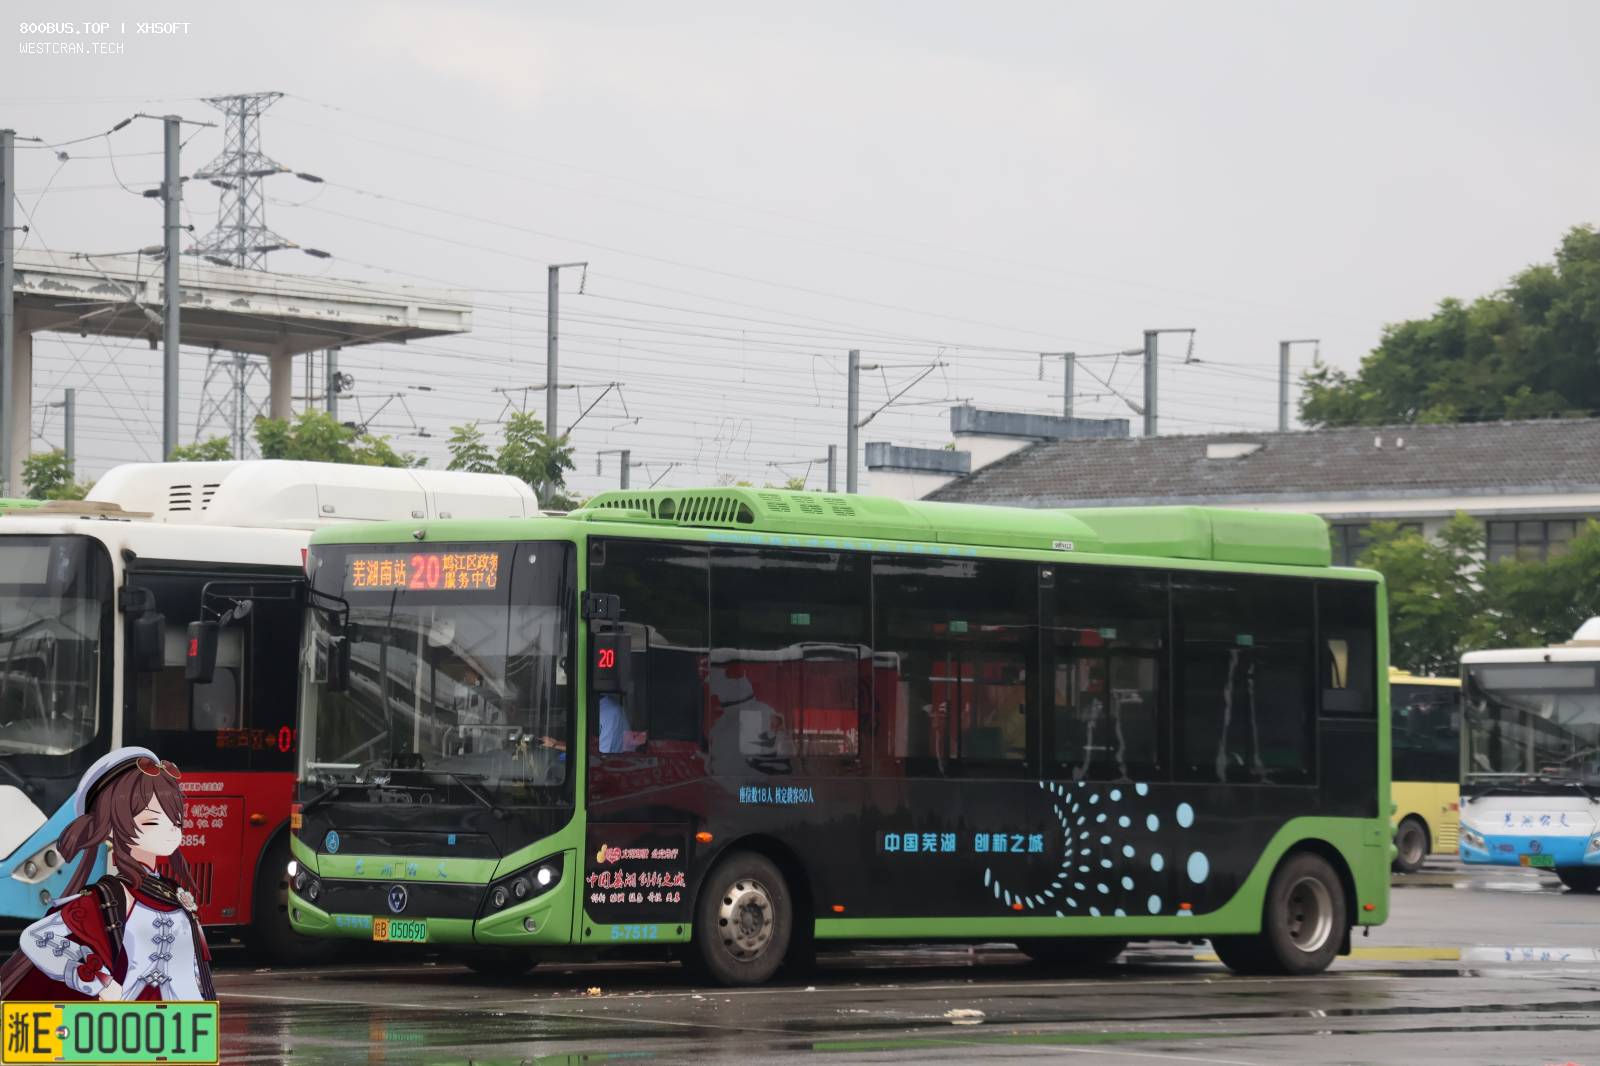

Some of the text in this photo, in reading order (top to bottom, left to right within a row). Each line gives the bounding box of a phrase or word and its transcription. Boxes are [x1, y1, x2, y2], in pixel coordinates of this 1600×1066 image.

[353, 560, 406, 586] 芜湖南站
[410, 555, 440, 589] 20
[444, 572, 497, 588] 服务中心
[598, 649, 614, 668] 20
[884, 832, 1044, 853] 中国芜湖 创新之城
